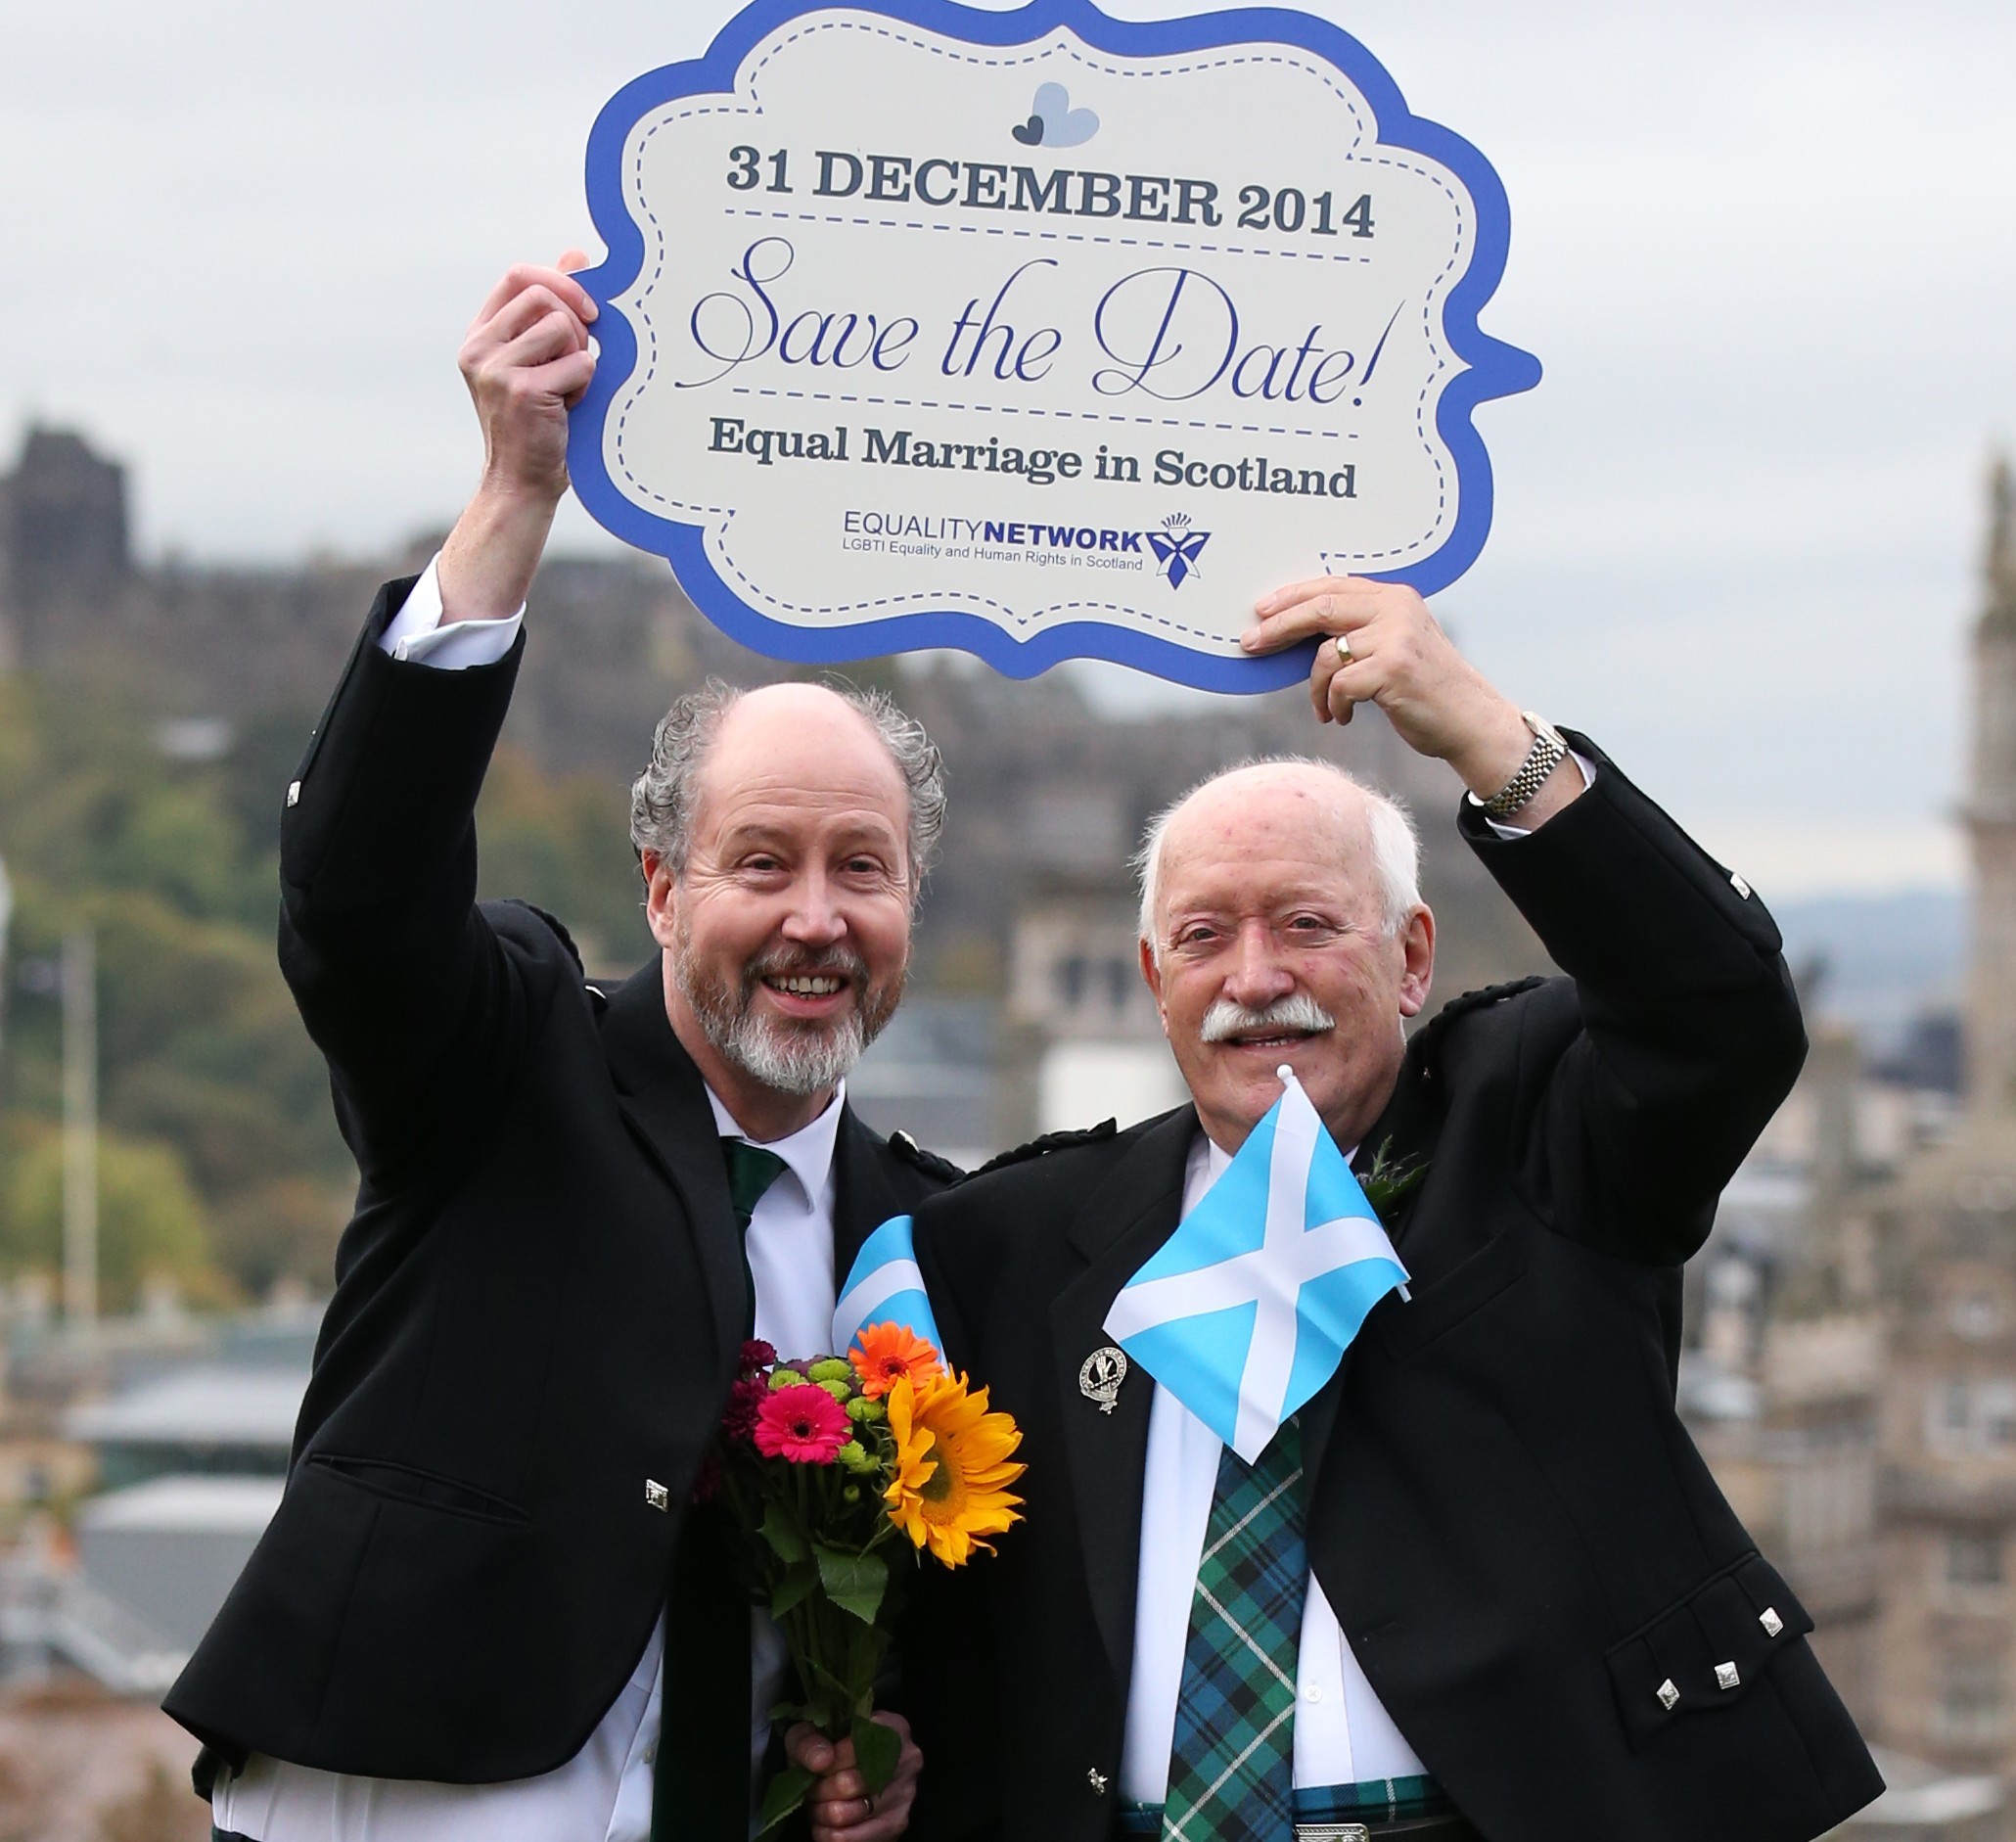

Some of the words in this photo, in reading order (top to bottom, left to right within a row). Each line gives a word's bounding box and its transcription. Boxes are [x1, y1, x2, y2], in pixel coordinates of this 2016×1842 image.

[727, 145, 794, 194] 31
[813, 151, 1222, 227] DECEMBER
[1237, 185, 1375, 239] 2014
[674, 237, 919, 388] Save
[941, 258, 1062, 382] the
[1092, 258, 1405, 407] Date!
[708, 417, 849, 466] Equal
[861, 428, 1082, 485] Marriage
[1094, 445, 1141, 483] in
[1154, 449, 1357, 498] Scotland
[843, 538, 885, 553] LGBTI
[890, 541, 940, 559] Equality
[945, 545, 969, 558] and
[974, 547, 1021, 562] Human
[1026, 550, 1066, 567] Rights
[1071, 553, 1082, 566] in
[1086, 555, 1142, 570] Scotland
